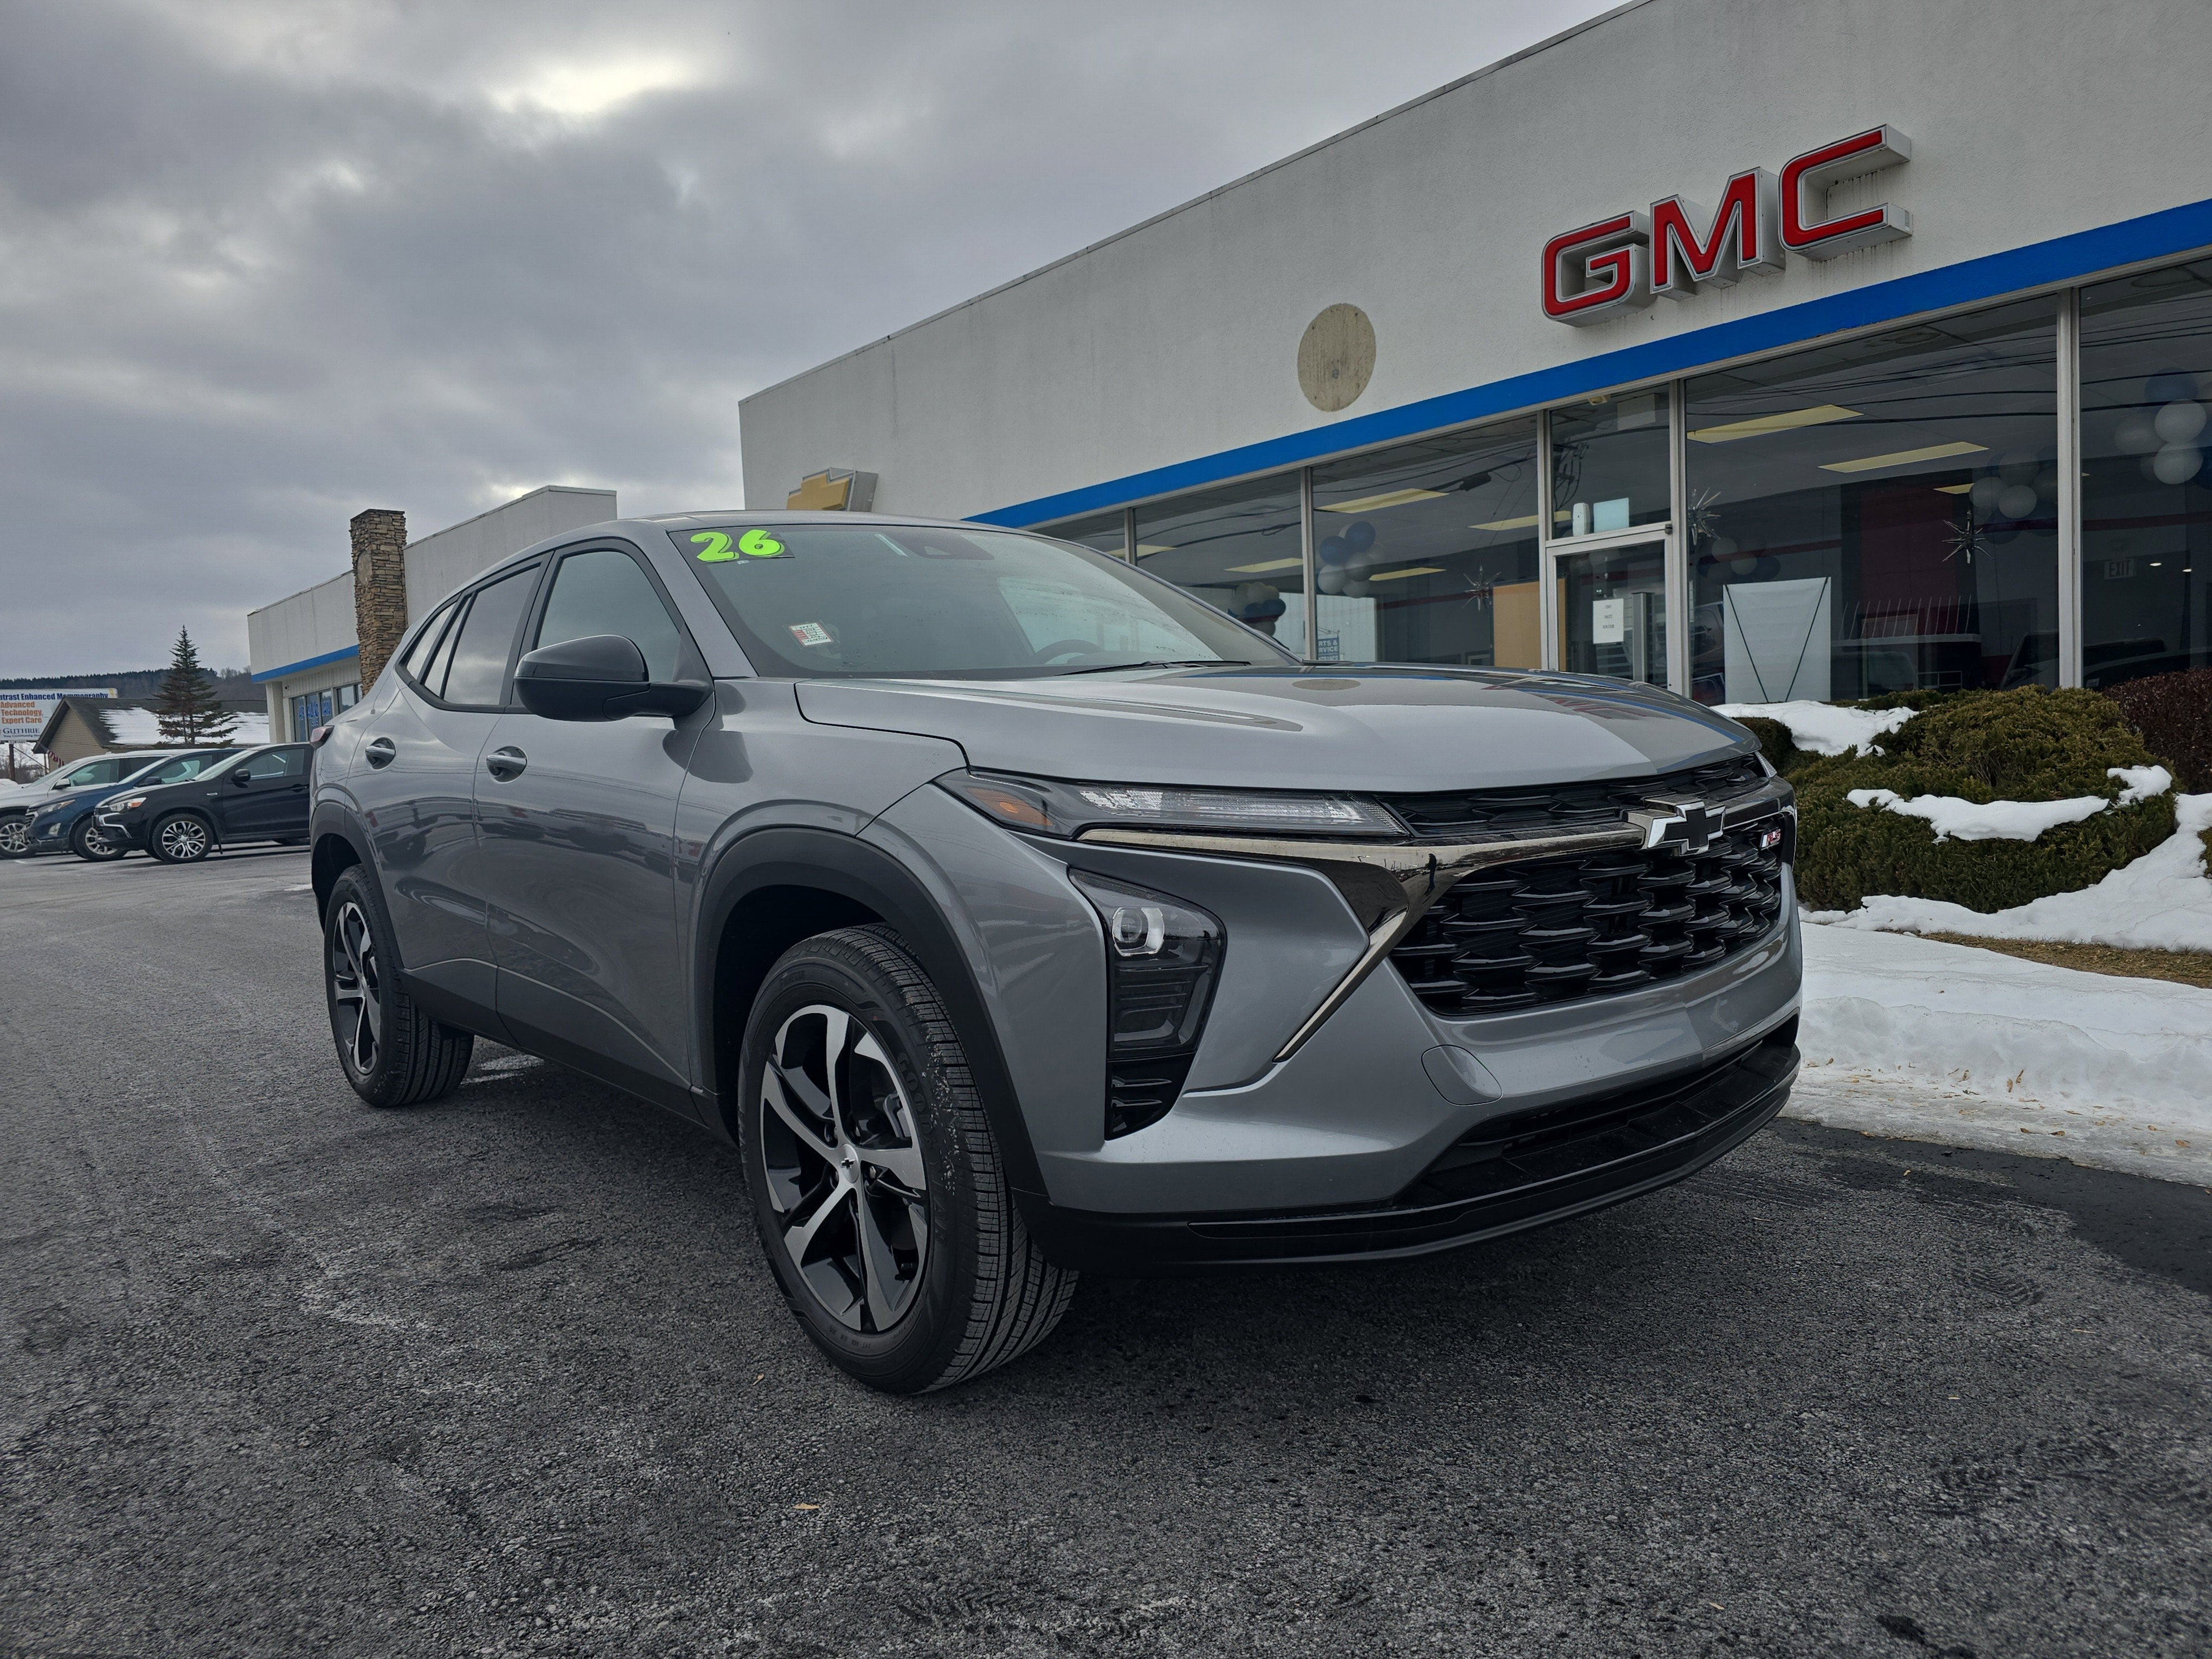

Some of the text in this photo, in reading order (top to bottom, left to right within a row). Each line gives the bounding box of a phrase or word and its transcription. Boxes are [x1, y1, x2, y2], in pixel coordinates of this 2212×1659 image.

[1541, 124, 1893, 321] GMC
[690, 529, 785, 562] 26
[2108, 560, 2131, 578] EXIT
[1765, 828, 1781, 847] RS
